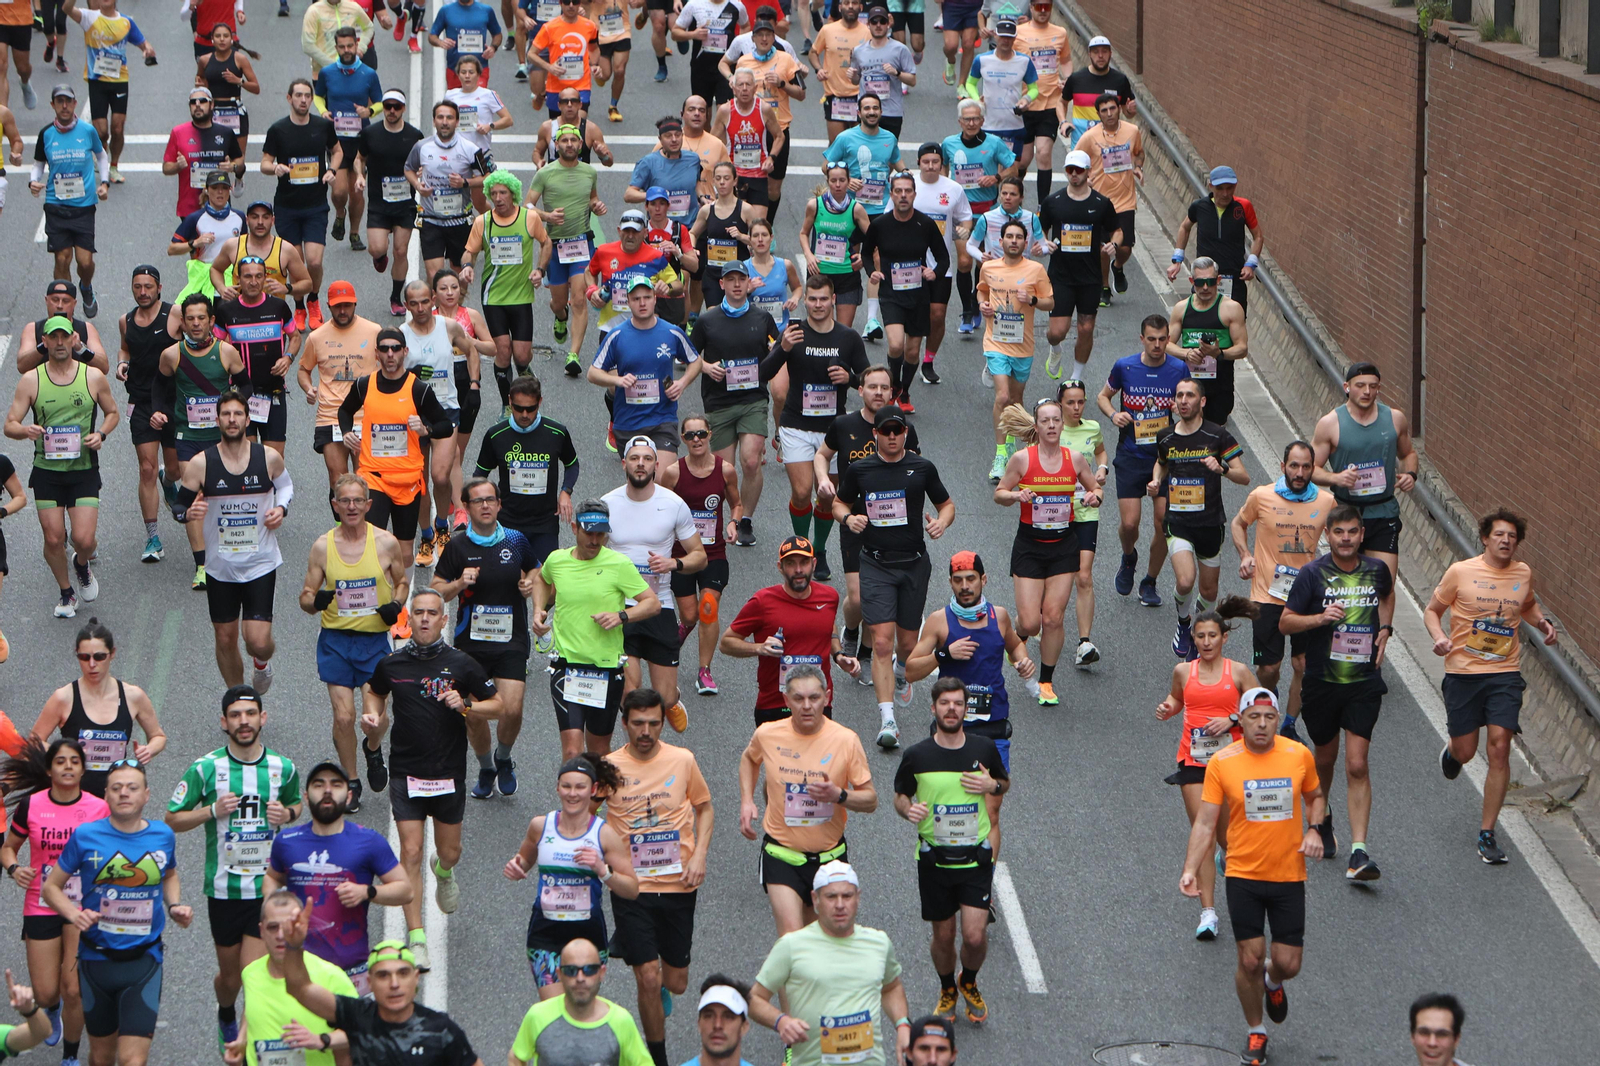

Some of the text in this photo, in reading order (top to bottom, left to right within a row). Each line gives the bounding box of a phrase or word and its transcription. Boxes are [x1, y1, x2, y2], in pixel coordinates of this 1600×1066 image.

[734, 133, 760, 144] ASSA
[805, 346, 839, 357] GYMSHARK
[1129, 386, 1172, 395] BASTITANIA
[1146, 410, 1165, 420] ZURICH
[1168, 447, 1210, 459] Firehawk
[220, 502, 258, 510] KUMON
[1325, 586, 1375, 597] RUNNING
[1487, 626, 1509, 635] ZURICH
[779, 766, 804, 775] Maratón
[650, 792, 671, 800] Sevilla
[1260, 794, 1277, 802] 9993
[647, 833, 674, 842] ZURICH
[557, 876, 585, 885] ZURICH
[838, 1015, 867, 1027] ZURICH
[839, 1033, 857, 1041] 5417
